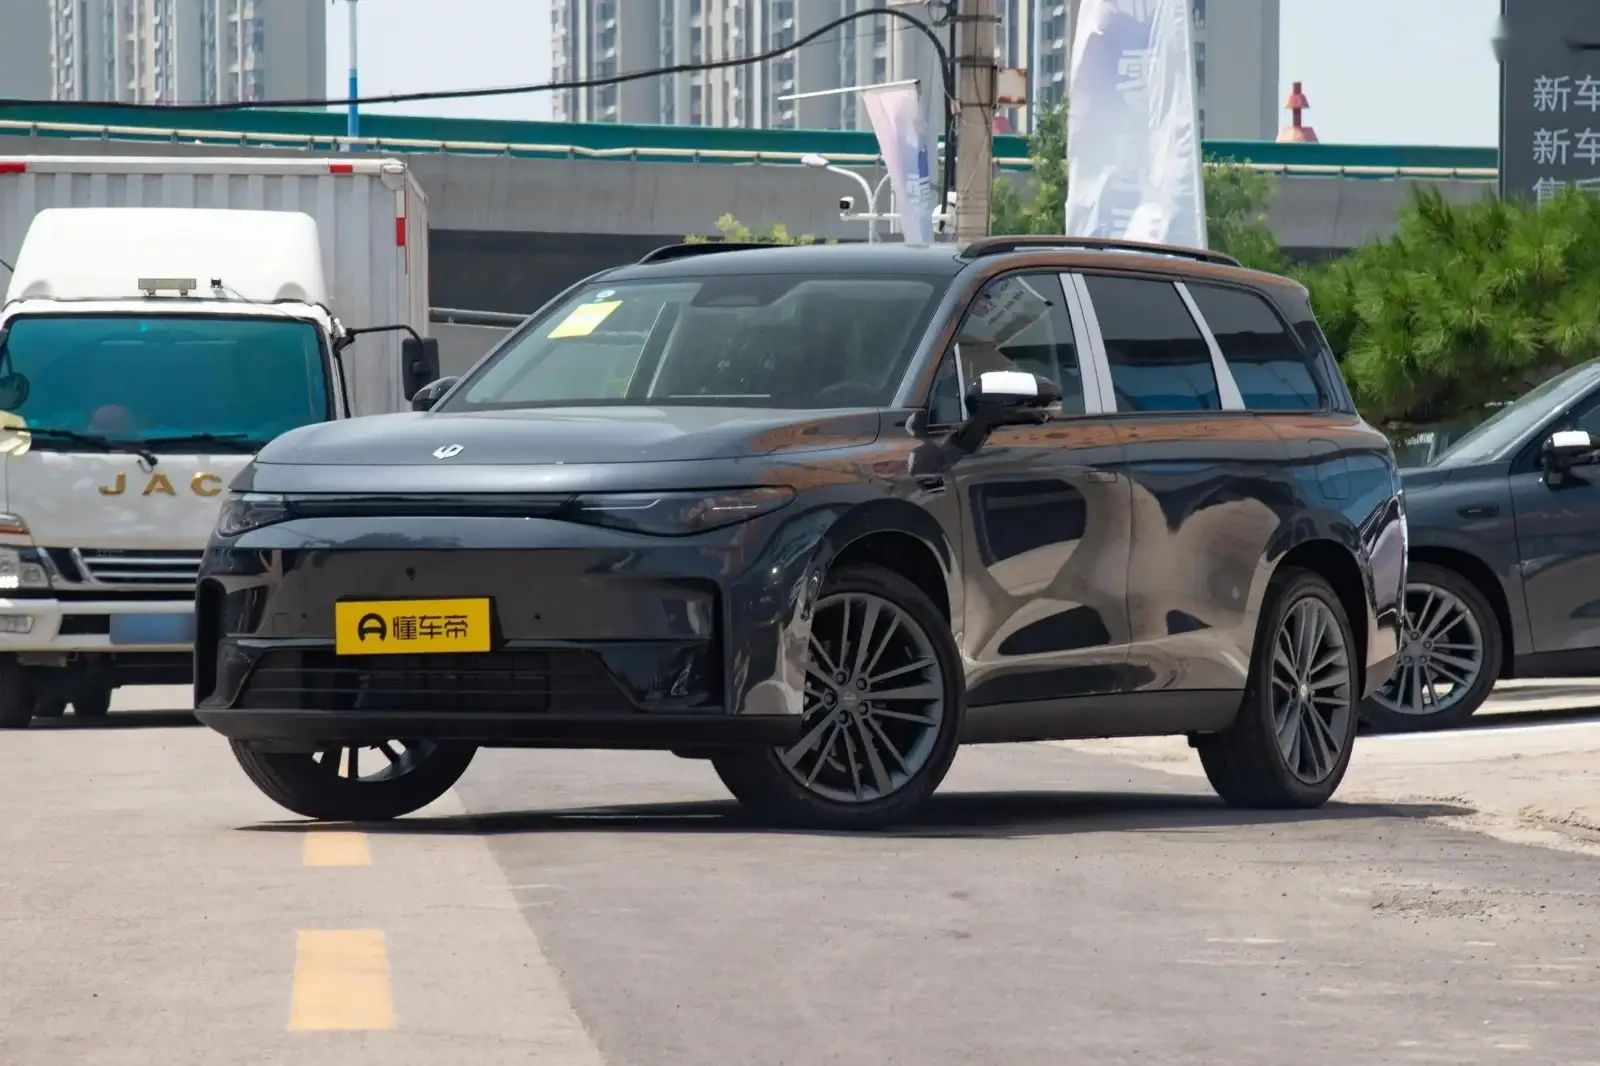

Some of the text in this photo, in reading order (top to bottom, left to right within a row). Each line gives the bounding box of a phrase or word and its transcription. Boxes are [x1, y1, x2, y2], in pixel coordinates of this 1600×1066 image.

[1533, 75, 1600, 113] 新车
[1533, 128, 1600, 165] 新车
[98, 471, 223, 496] JAC
[392, 614, 469, 641] 懂车帝
